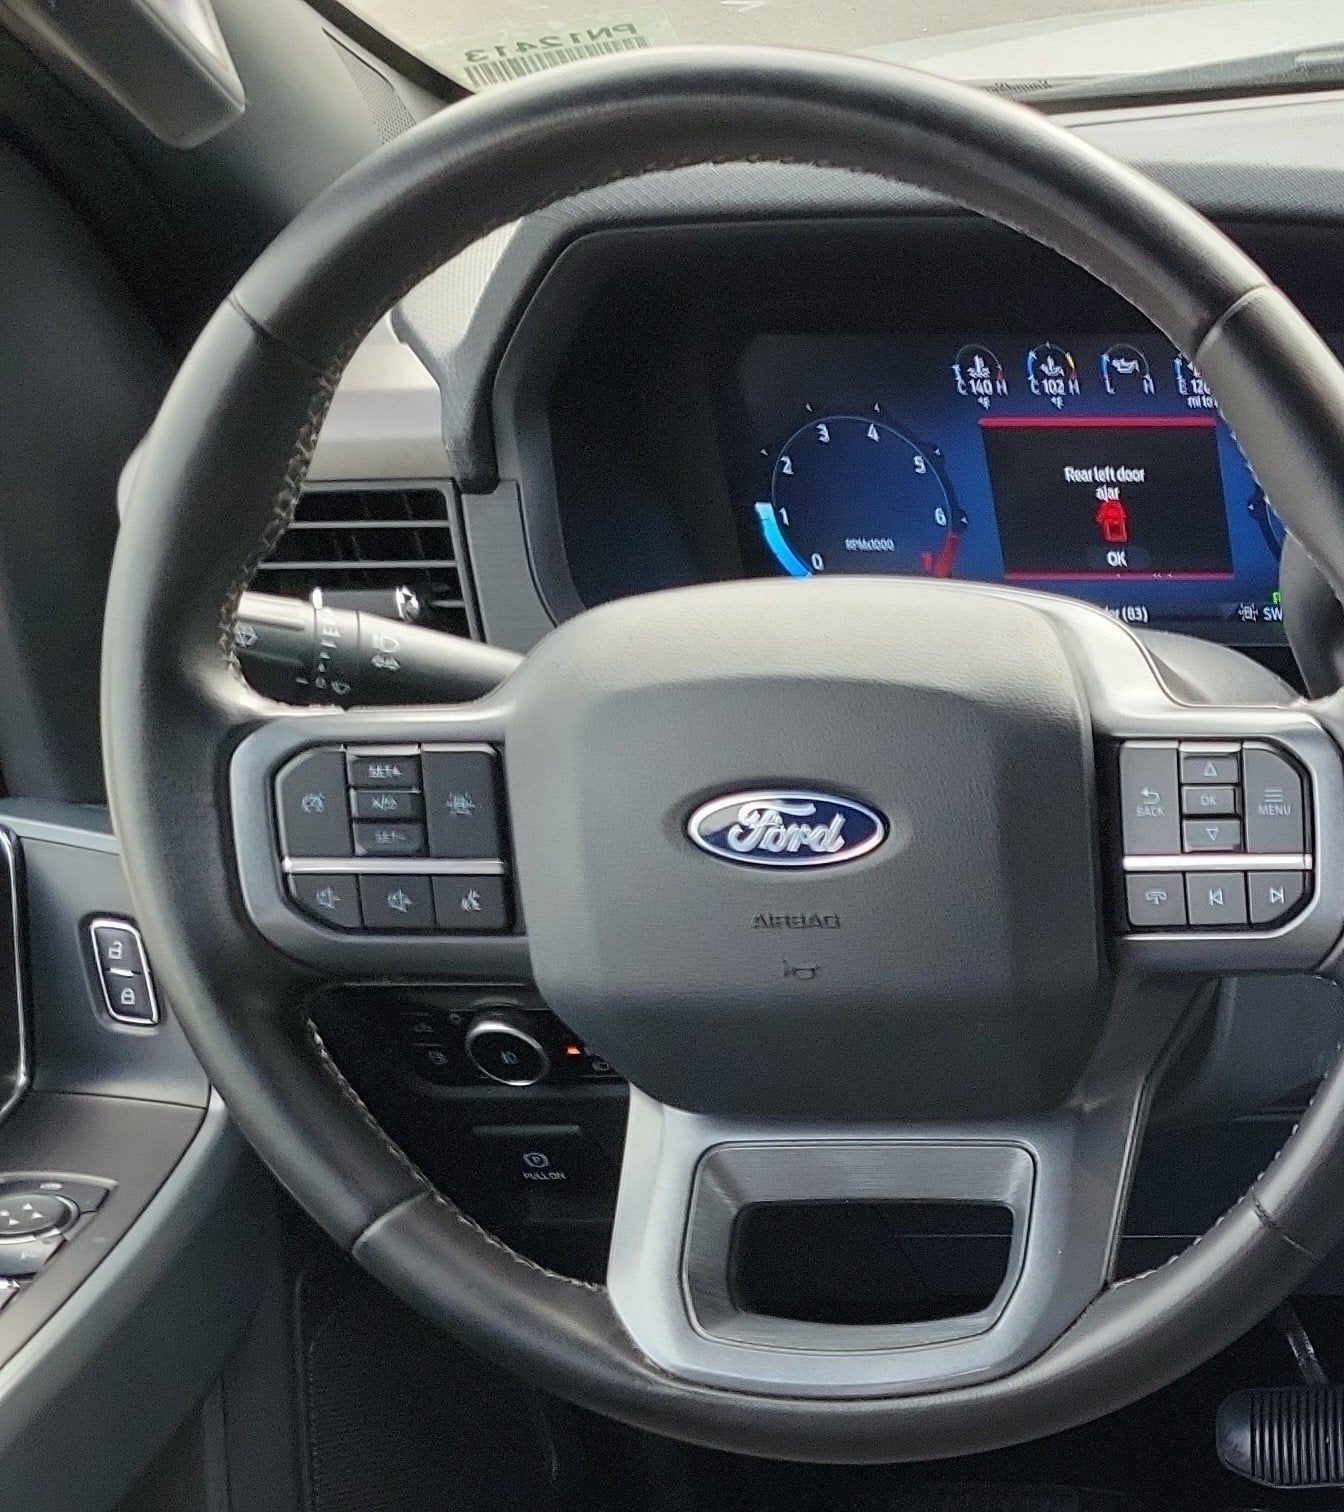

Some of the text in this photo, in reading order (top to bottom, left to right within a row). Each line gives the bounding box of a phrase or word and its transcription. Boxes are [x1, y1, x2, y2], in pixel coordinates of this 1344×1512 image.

[970, 380, 993, 395] 140
[1043, 380, 1065, 395] 102
[816, 423, 830, 443] 3
[867, 423, 880, 442] 4
[780, 455, 794, 475] 2
[913, 455, 927, 474] 5
[1063, 466, 1145, 482] Rear left door
[1096, 485, 1120, 501] ajar
[780, 507, 790, 526] 1
[934, 507, 947, 526] 6
[811, 553, 825, 571] 0
[1107, 551, 1128, 567] OK
[1137, 806, 1164, 817] BACK
[1258, 805, 1291, 815] MENU
[728, 802, 846, 852] Ford
[752, 914, 841, 930] AIRBAG
